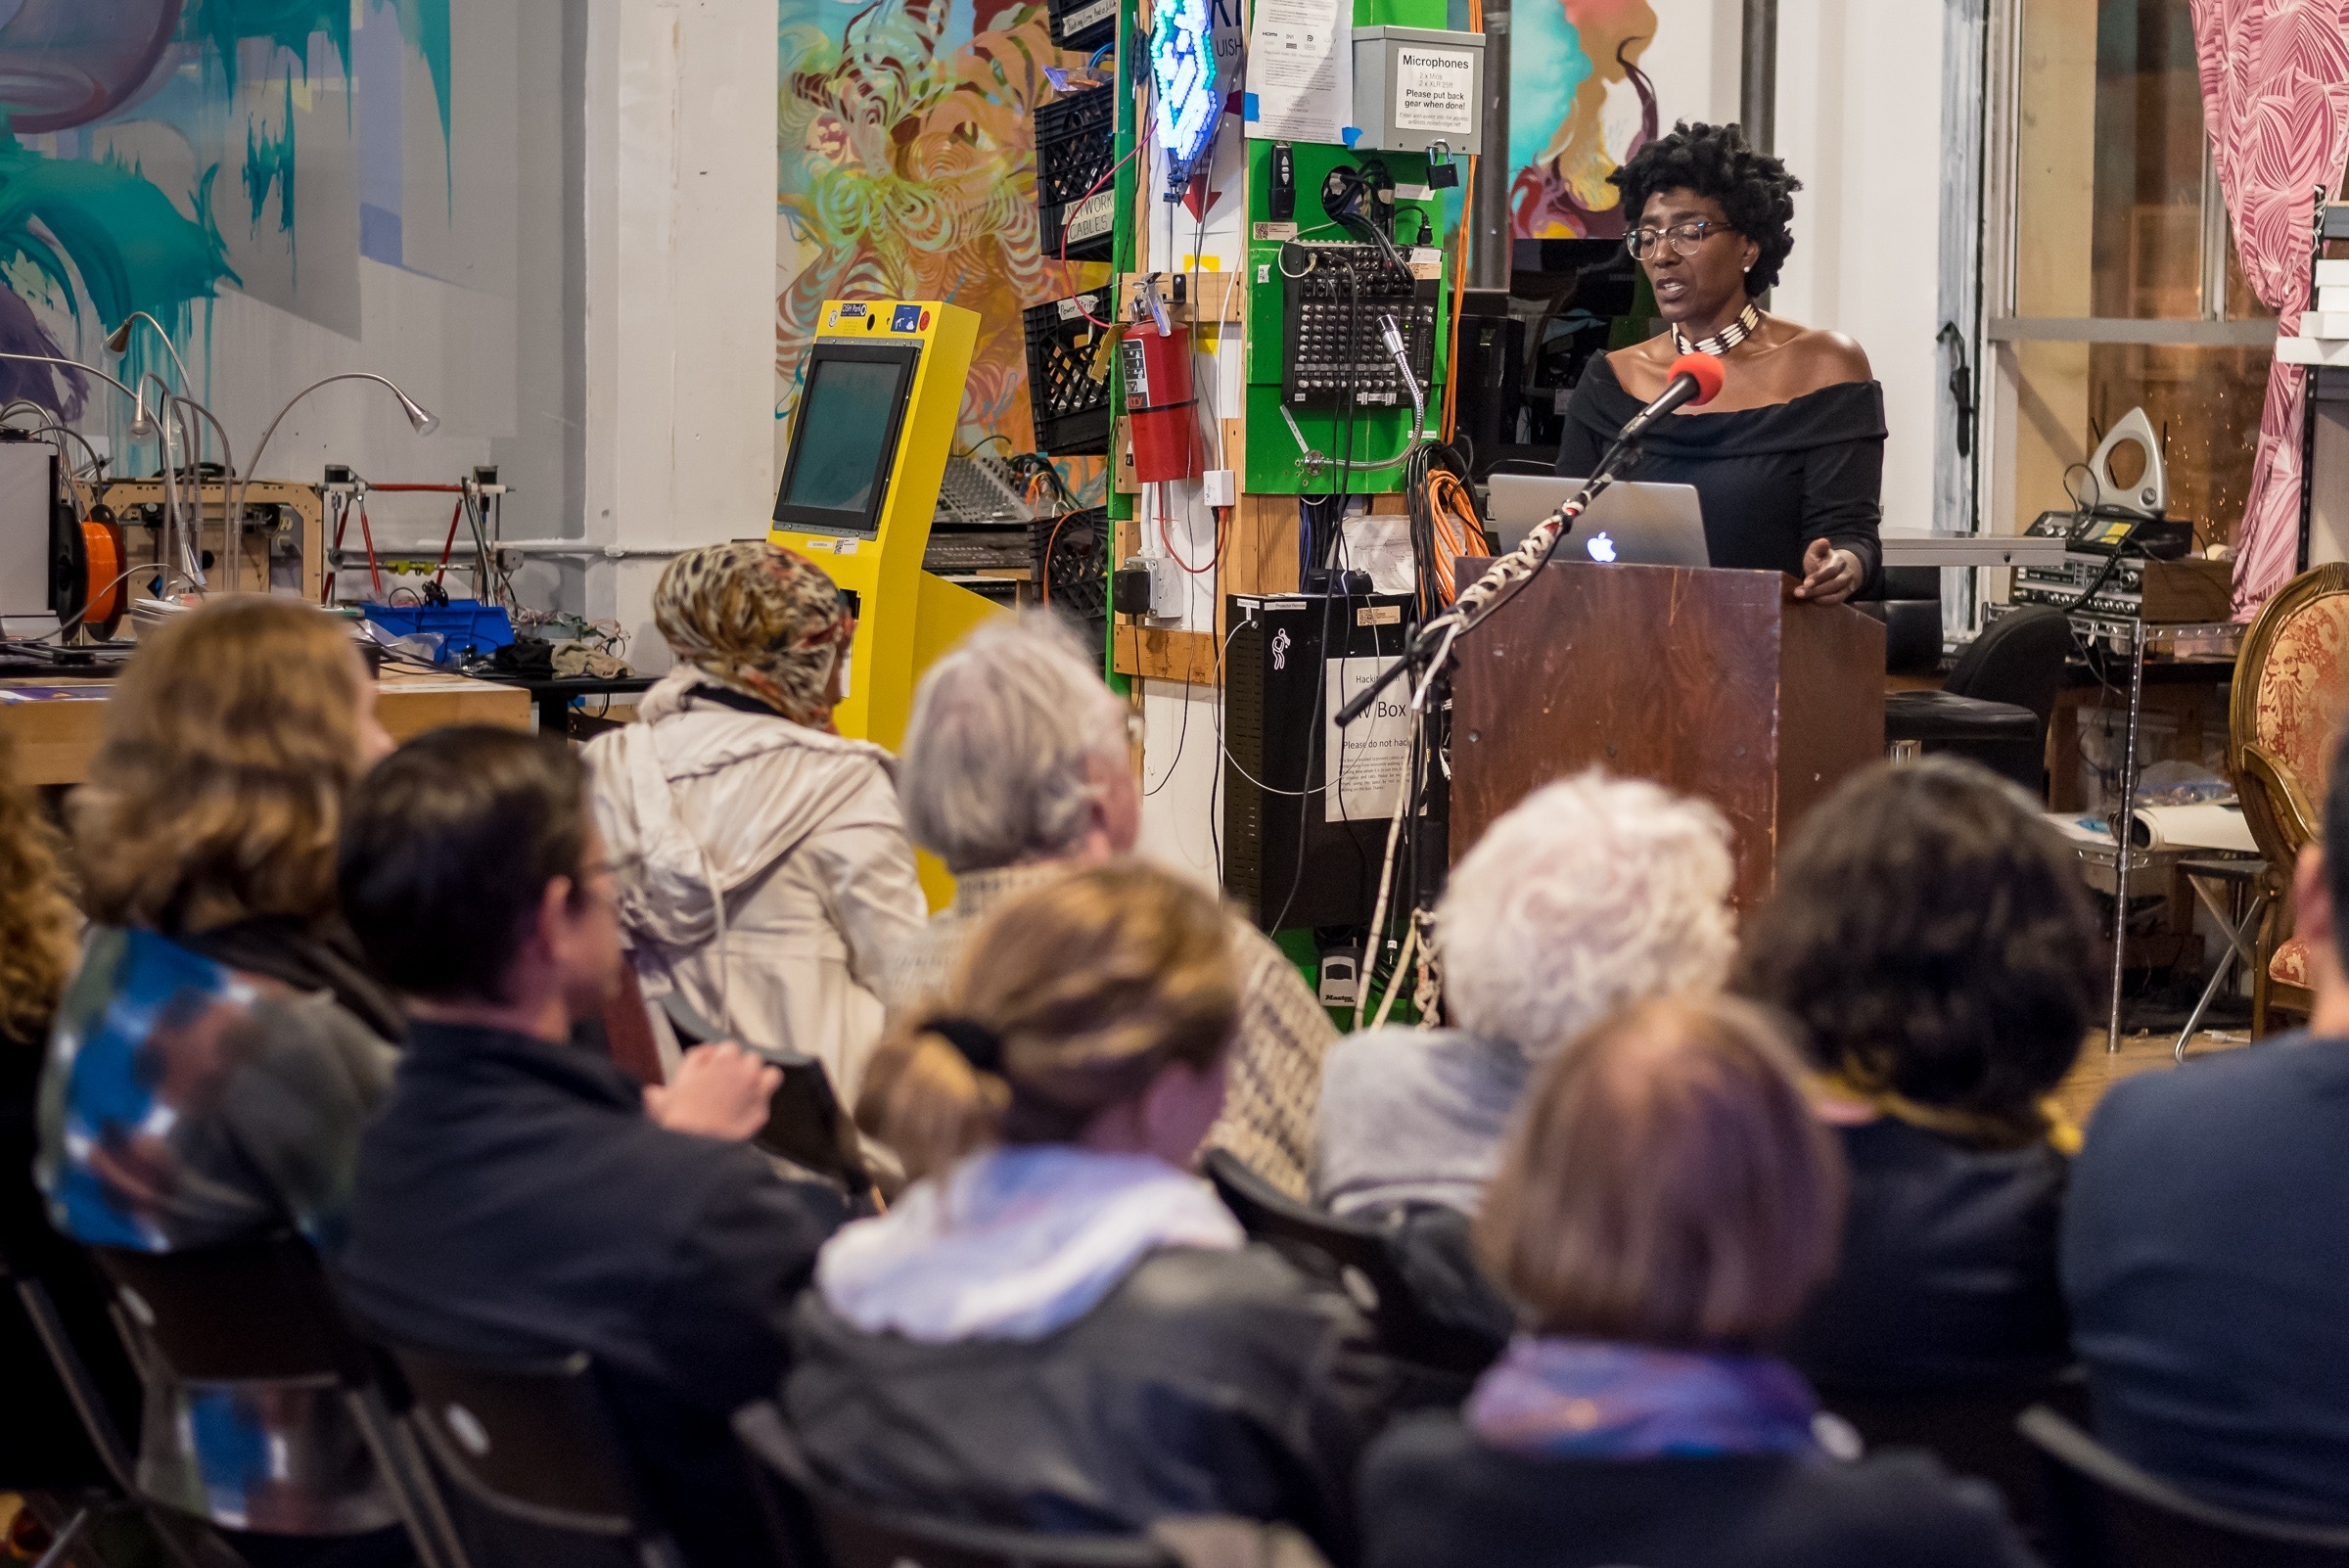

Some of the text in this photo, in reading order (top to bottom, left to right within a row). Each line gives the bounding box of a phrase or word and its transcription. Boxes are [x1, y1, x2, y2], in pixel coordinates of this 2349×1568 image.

[1403, 55, 1469, 69] Microphones
[1405, 89, 1432, 99] Please
[1405, 100, 1422, 109] gear
[1070, 215, 1108, 241] CABLES
[1060, 304, 1076, 315] Power
[1378, 701, 1406, 717] Box
[1368, 740, 1378, 749] do
